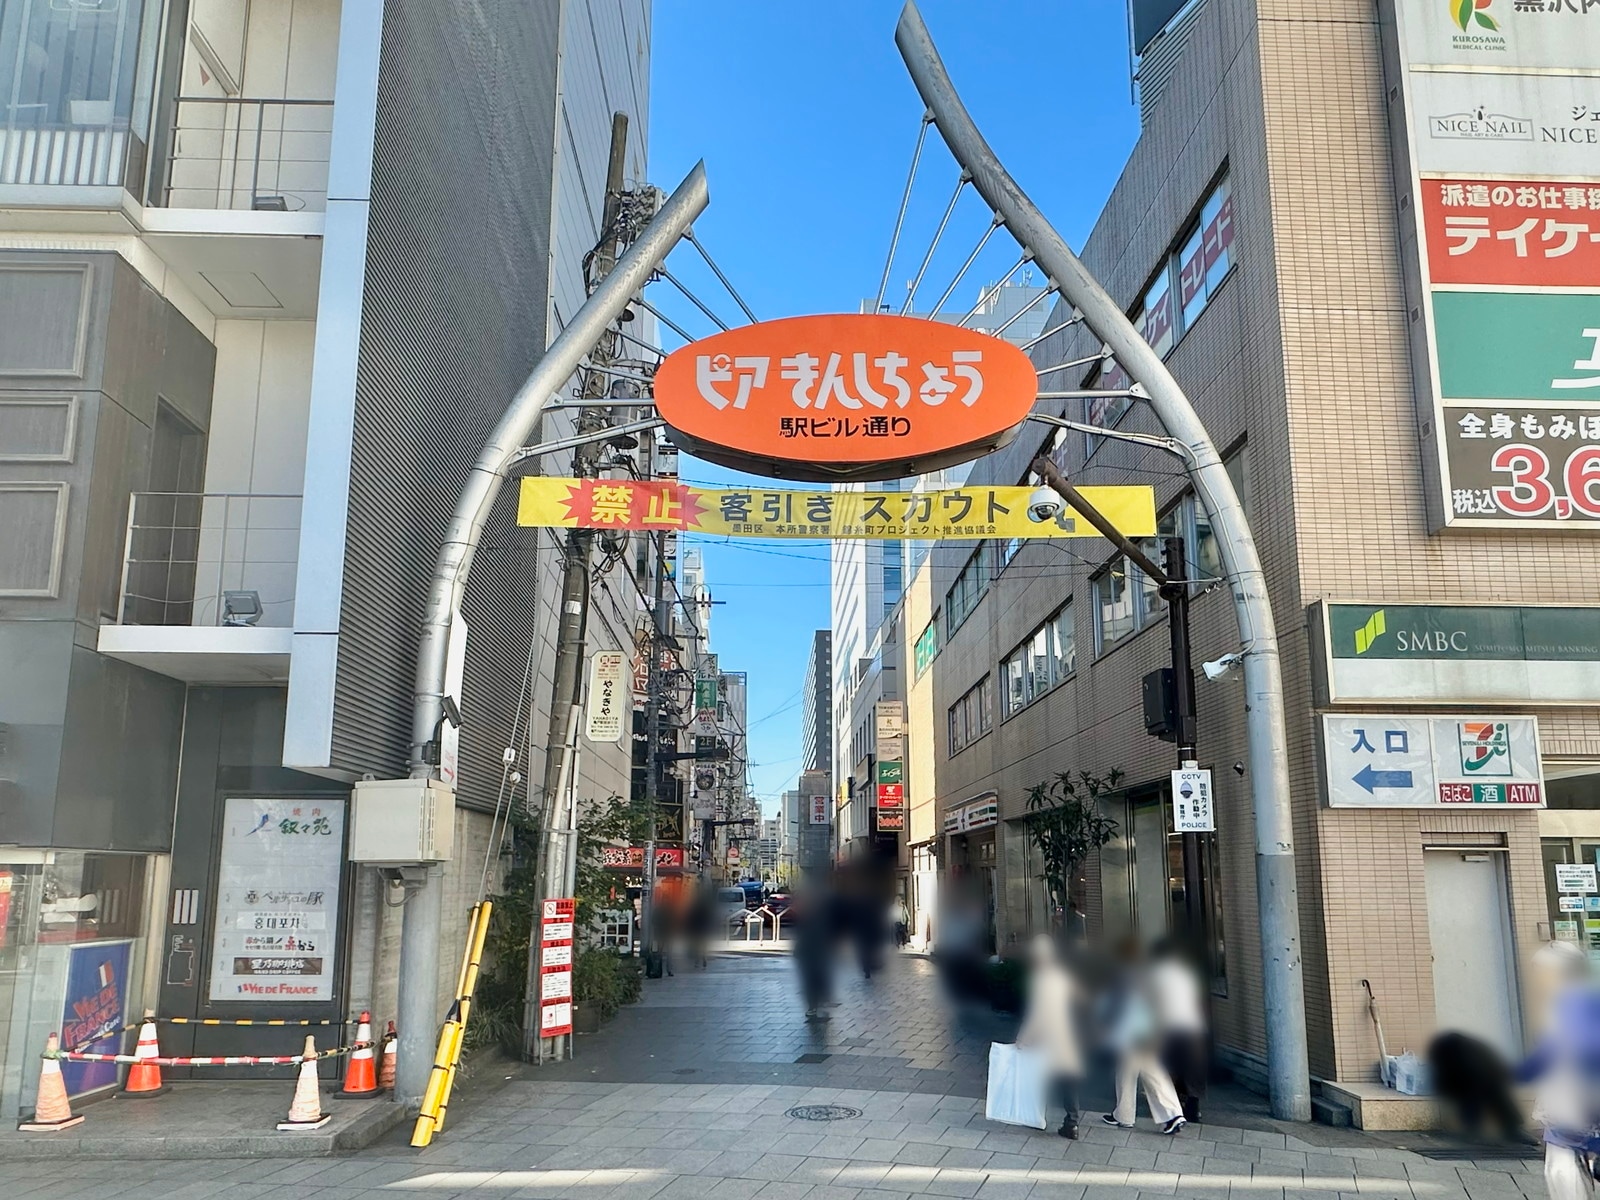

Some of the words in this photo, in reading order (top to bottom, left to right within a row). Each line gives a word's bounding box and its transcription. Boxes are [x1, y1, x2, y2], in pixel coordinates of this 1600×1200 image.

[1452, 35, 1506, 44] KUROSAWA
[1437, 120, 1478, 133] NICE
[1485, 120, 1527, 134] NAIL
[1541, 127, 1598, 143] NICE
[695, 353, 771, 411] ピア
[780, 350, 984, 411] きんしちょう
[779, 415, 912, 438] 駅ビル通り
[591, 485, 683, 525] 禁止
[720, 493, 834, 523] 客引き
[859, 491, 1010, 524] スカウト
[1452, 488, 1497, 514] 税込
[732, 524, 763, 534] 墨田区
[1397, 630, 1468, 652] SMBC
[1525, 645, 1555, 654] MITSUI
[1558, 646, 1598, 654] BANKING
[1351, 729, 1409, 754] 入口
[1440, 785, 1472, 802] たばこ
[1480, 785, 1499, 802] 酒
[1510, 785, 1537, 802] ATM
[278, 817, 332, 836] 叙々苑
[265, 986, 278, 994] DE
[279, 984, 318, 994] FRANCE
[64, 998, 120, 1048] FRANCE
